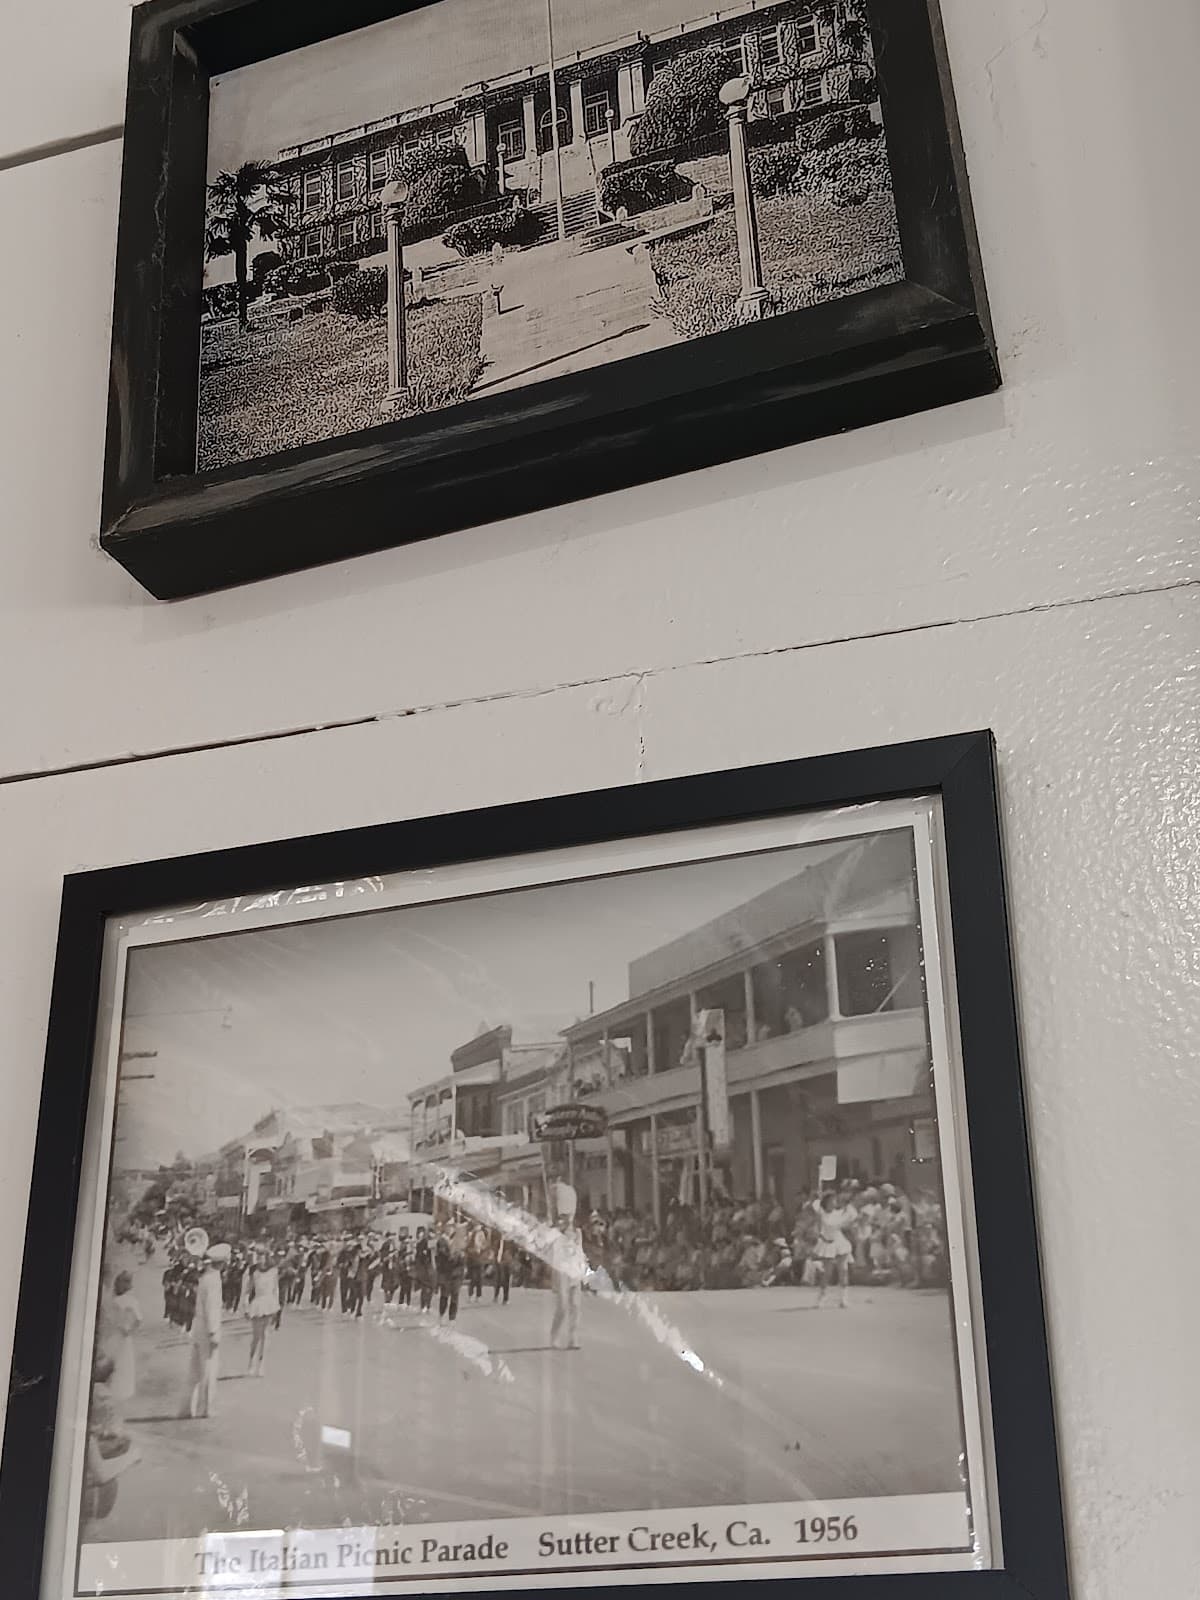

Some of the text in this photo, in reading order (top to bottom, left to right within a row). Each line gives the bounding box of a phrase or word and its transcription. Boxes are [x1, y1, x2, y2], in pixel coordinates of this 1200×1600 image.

[249, 1546, 328, 1573] Italian
[336, 1540, 412, 1568] Picnic
[421, 1535, 509, 1563] Parade
[538, 1531, 620, 1557] Sutter
[628, 1522, 718, 1553] Creek,
[725, 1521, 771, 1547] Ca.
[794, 1515, 858, 1544] 1956
